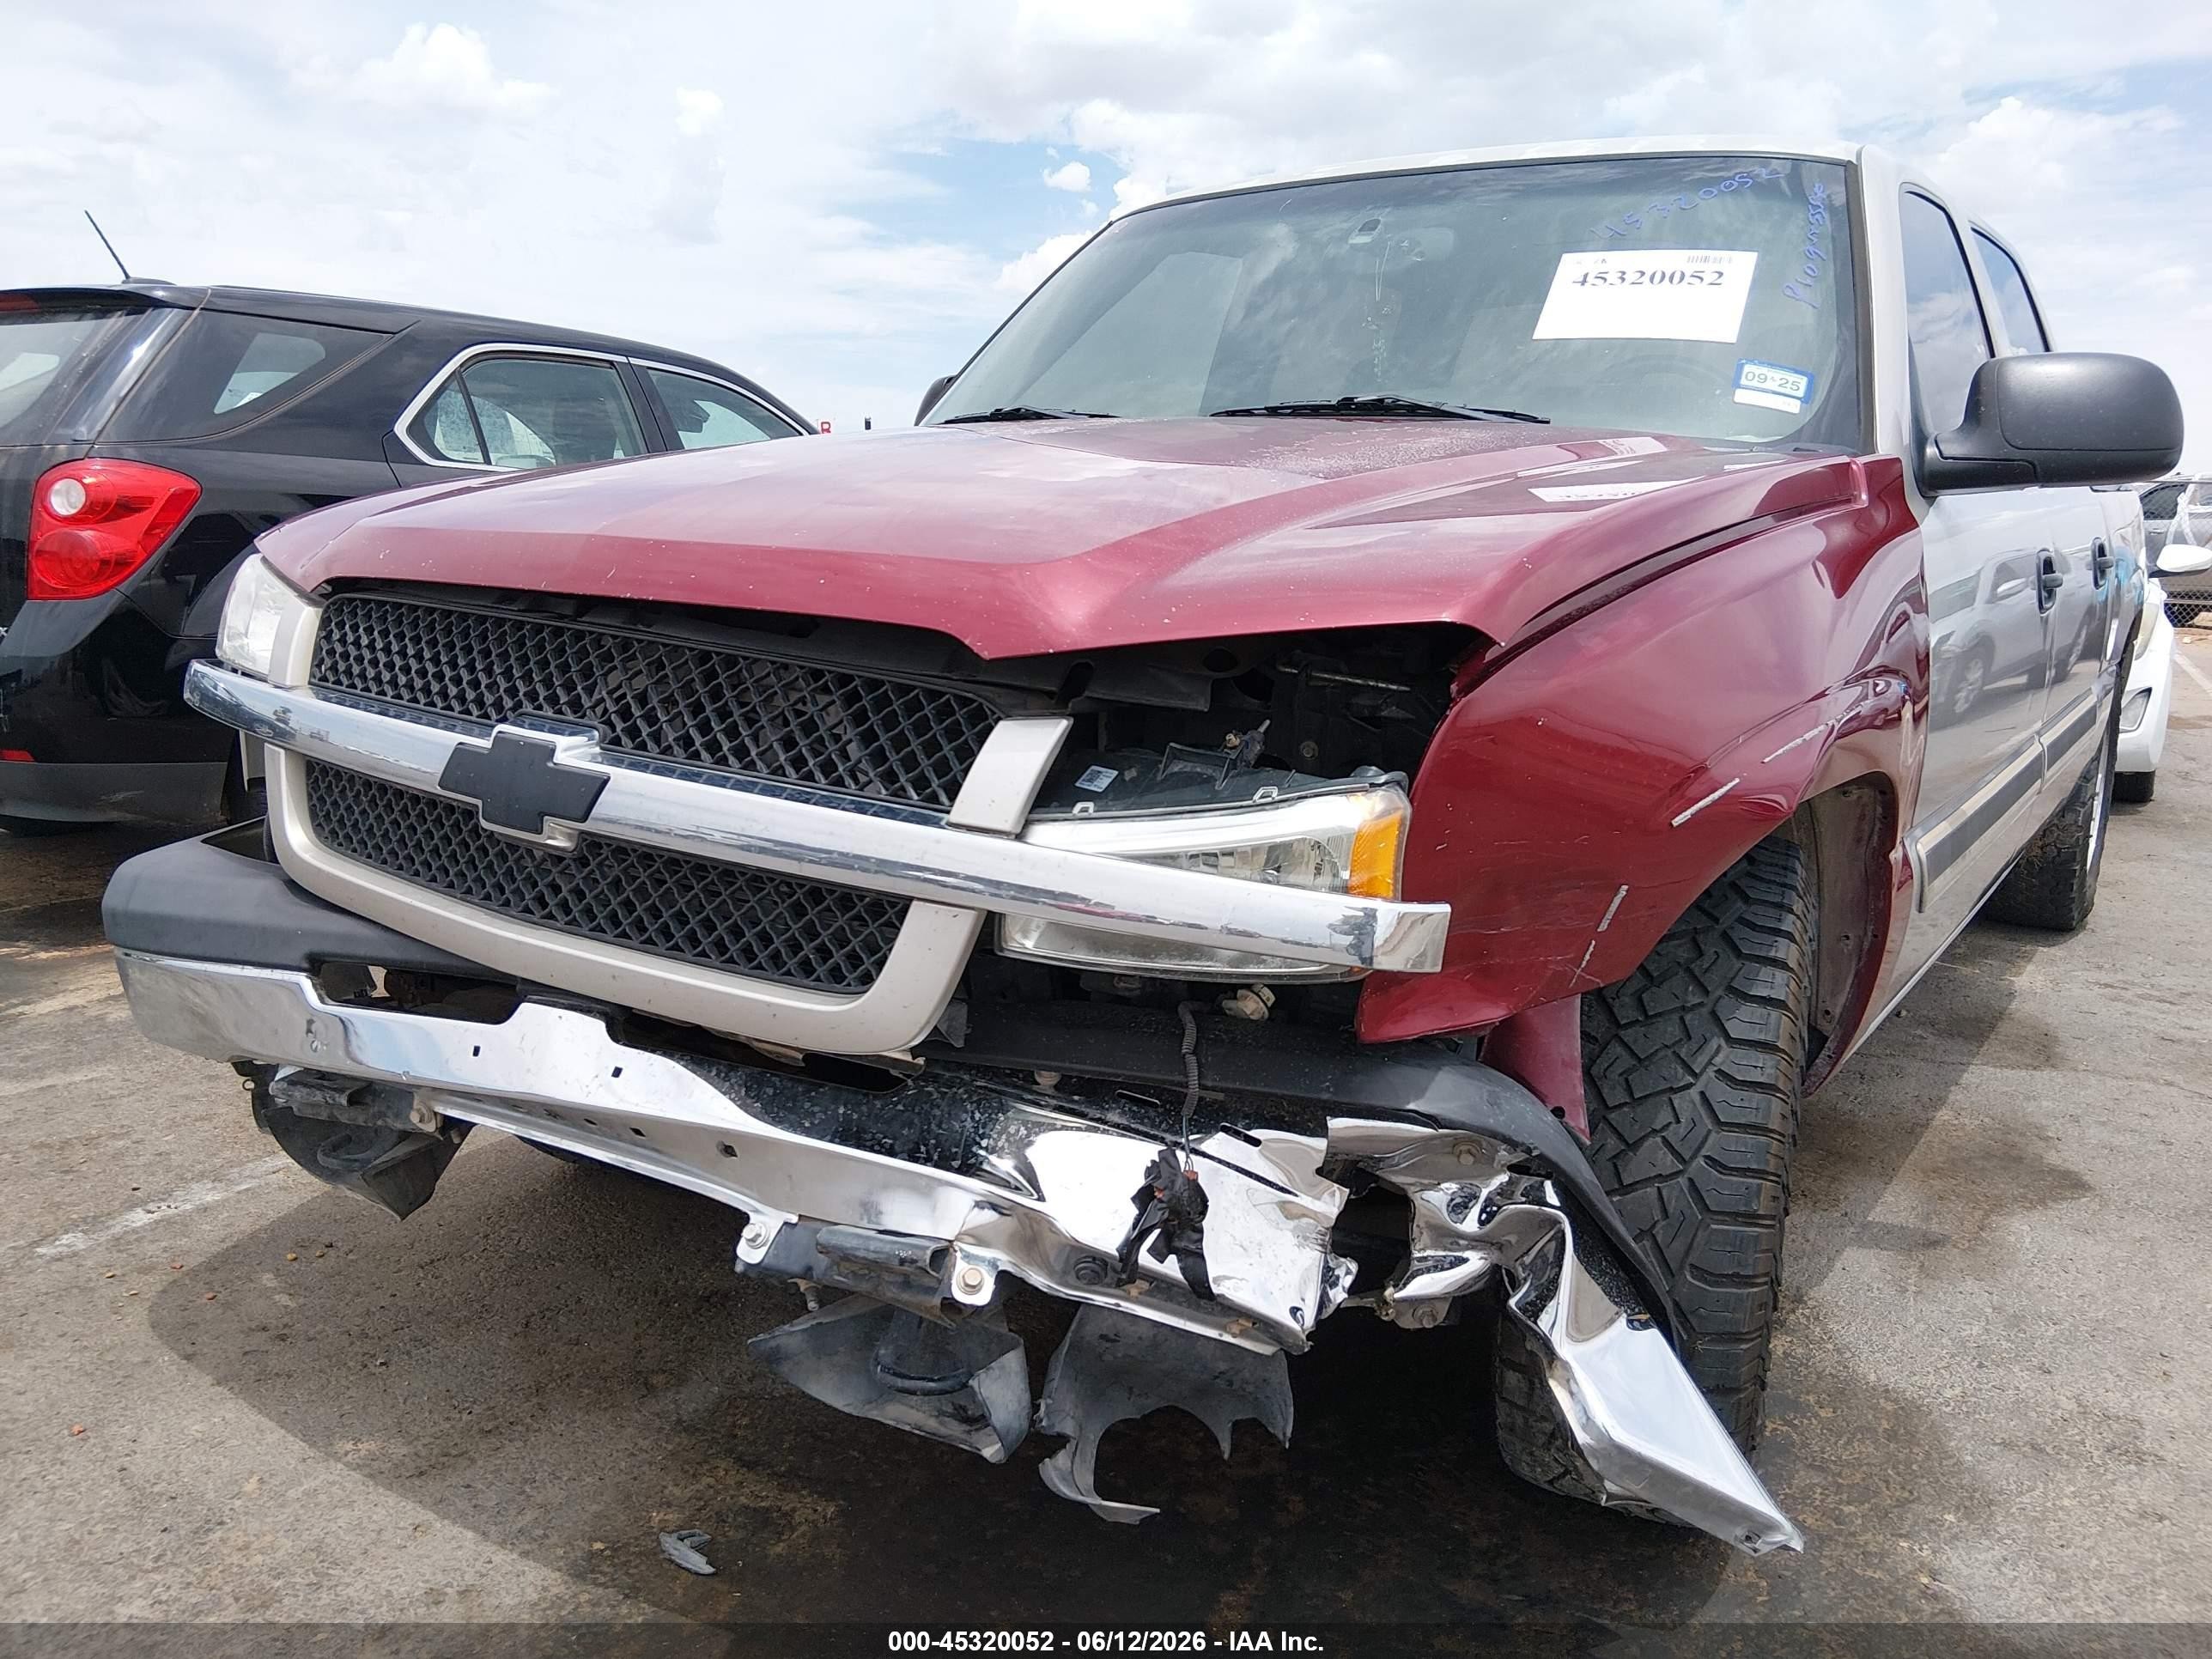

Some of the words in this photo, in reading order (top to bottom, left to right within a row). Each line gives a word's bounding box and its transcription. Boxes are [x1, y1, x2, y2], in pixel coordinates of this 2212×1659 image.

[1572, 270, 1724, 287] 45320052
[1745, 371, 1768, 384] 09
[1778, 378, 1802, 392] 25
